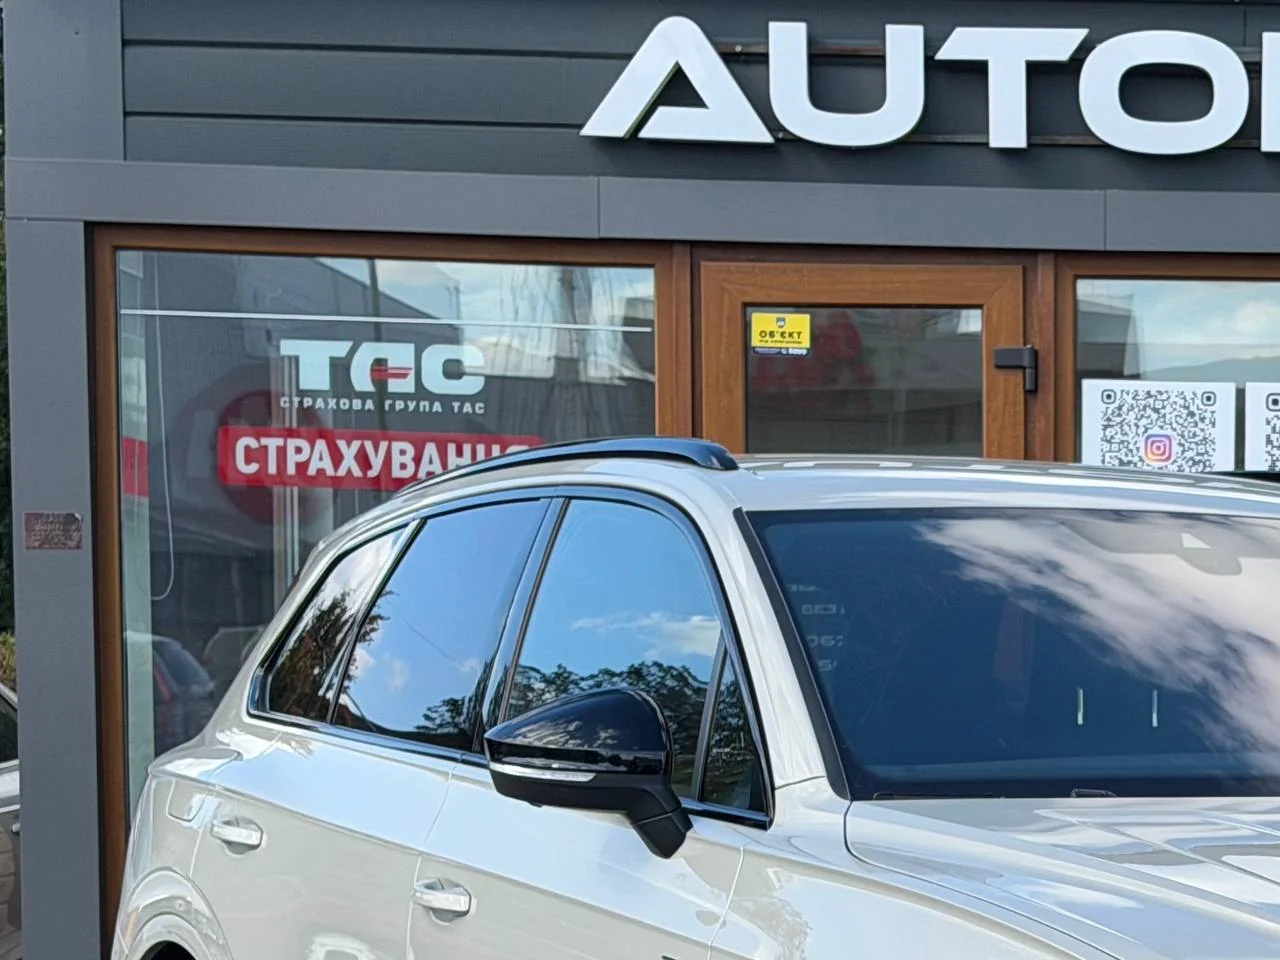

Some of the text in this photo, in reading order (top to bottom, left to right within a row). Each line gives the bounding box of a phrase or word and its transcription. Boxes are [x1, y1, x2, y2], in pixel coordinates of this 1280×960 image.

[280, 396, 485, 414] СТРАХОВА ГРУПА ТАС
[235, 436, 530, 478] СТРАХУВАН
